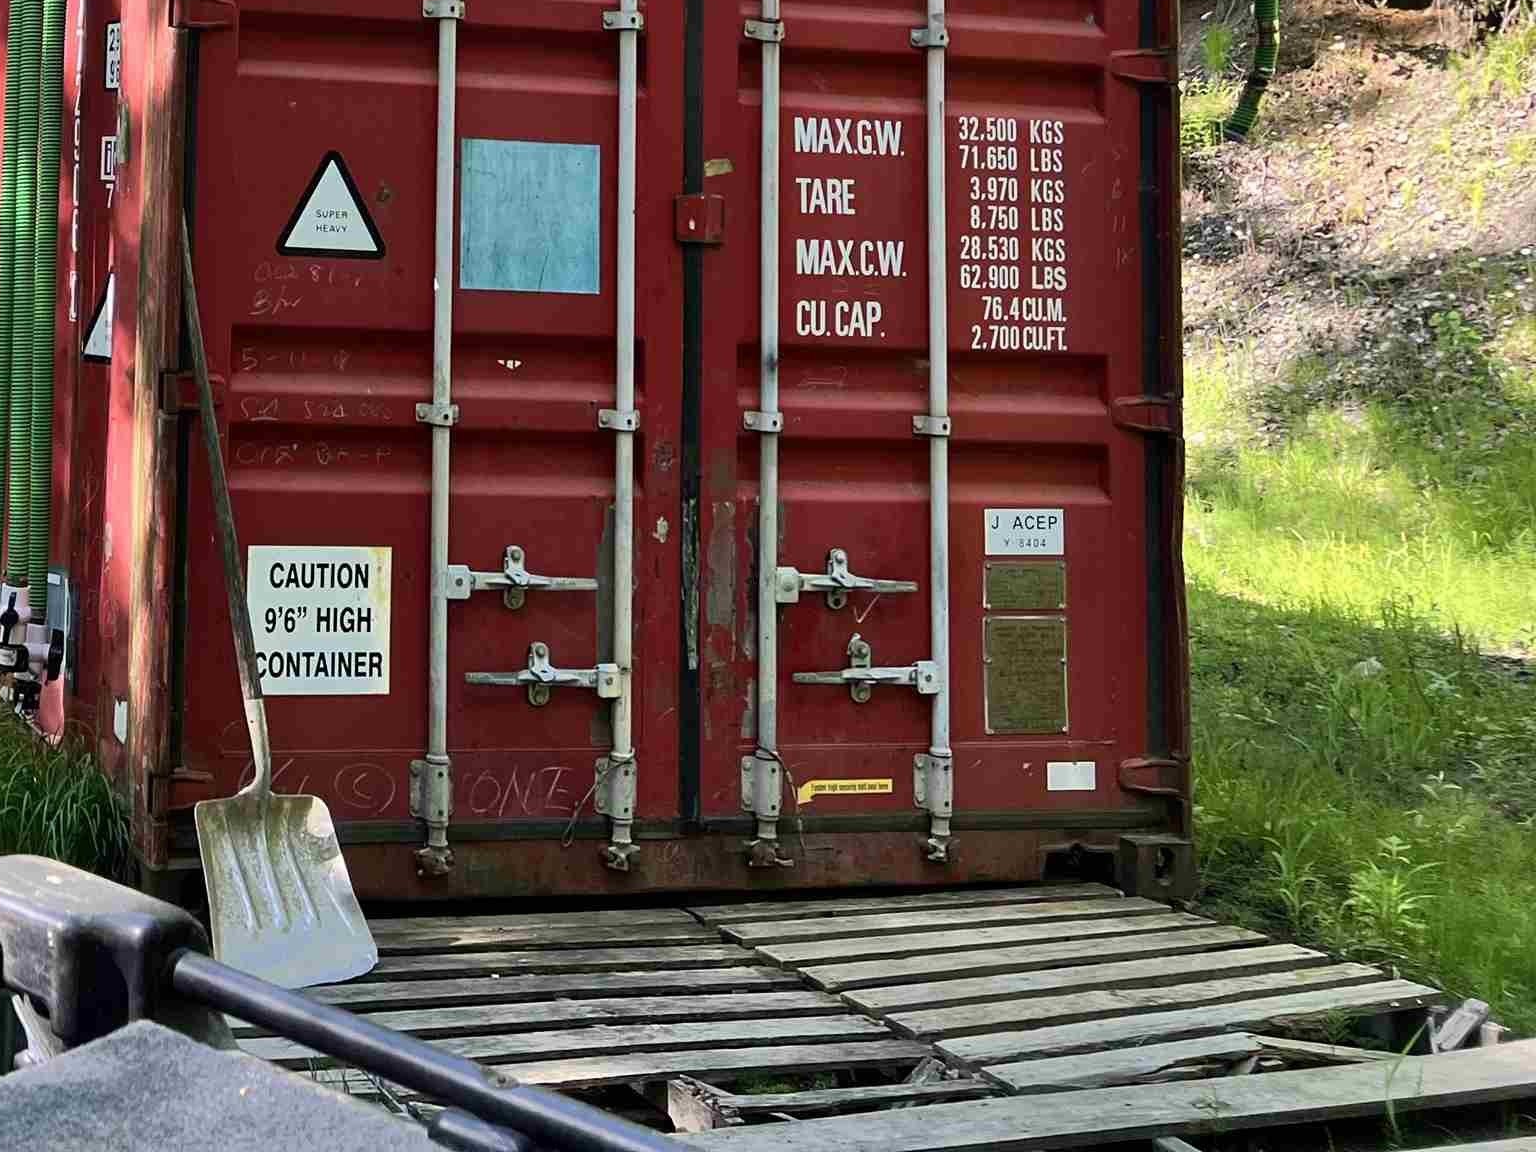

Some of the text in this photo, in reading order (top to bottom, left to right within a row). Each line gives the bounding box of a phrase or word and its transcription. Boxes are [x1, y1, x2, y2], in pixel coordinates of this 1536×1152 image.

[1030, 119, 1064, 145] KGS
[1030, 148, 1063, 173] LBS
[795, 178, 856, 215] TARE
[1031, 179, 1065, 204] KGS
[315, 208, 349, 221] SUPER
[1031, 207, 1064, 233] LBS
[315, 223, 349, 234] HEAVY
[1031, 238, 1066, 263] KGS
[1031, 266, 1068, 291] LBS
[1012, 515, 1058, 530] ACEP
[269, 562, 370, 590] CAUTION
[316, 607, 373, 634] HIGH
